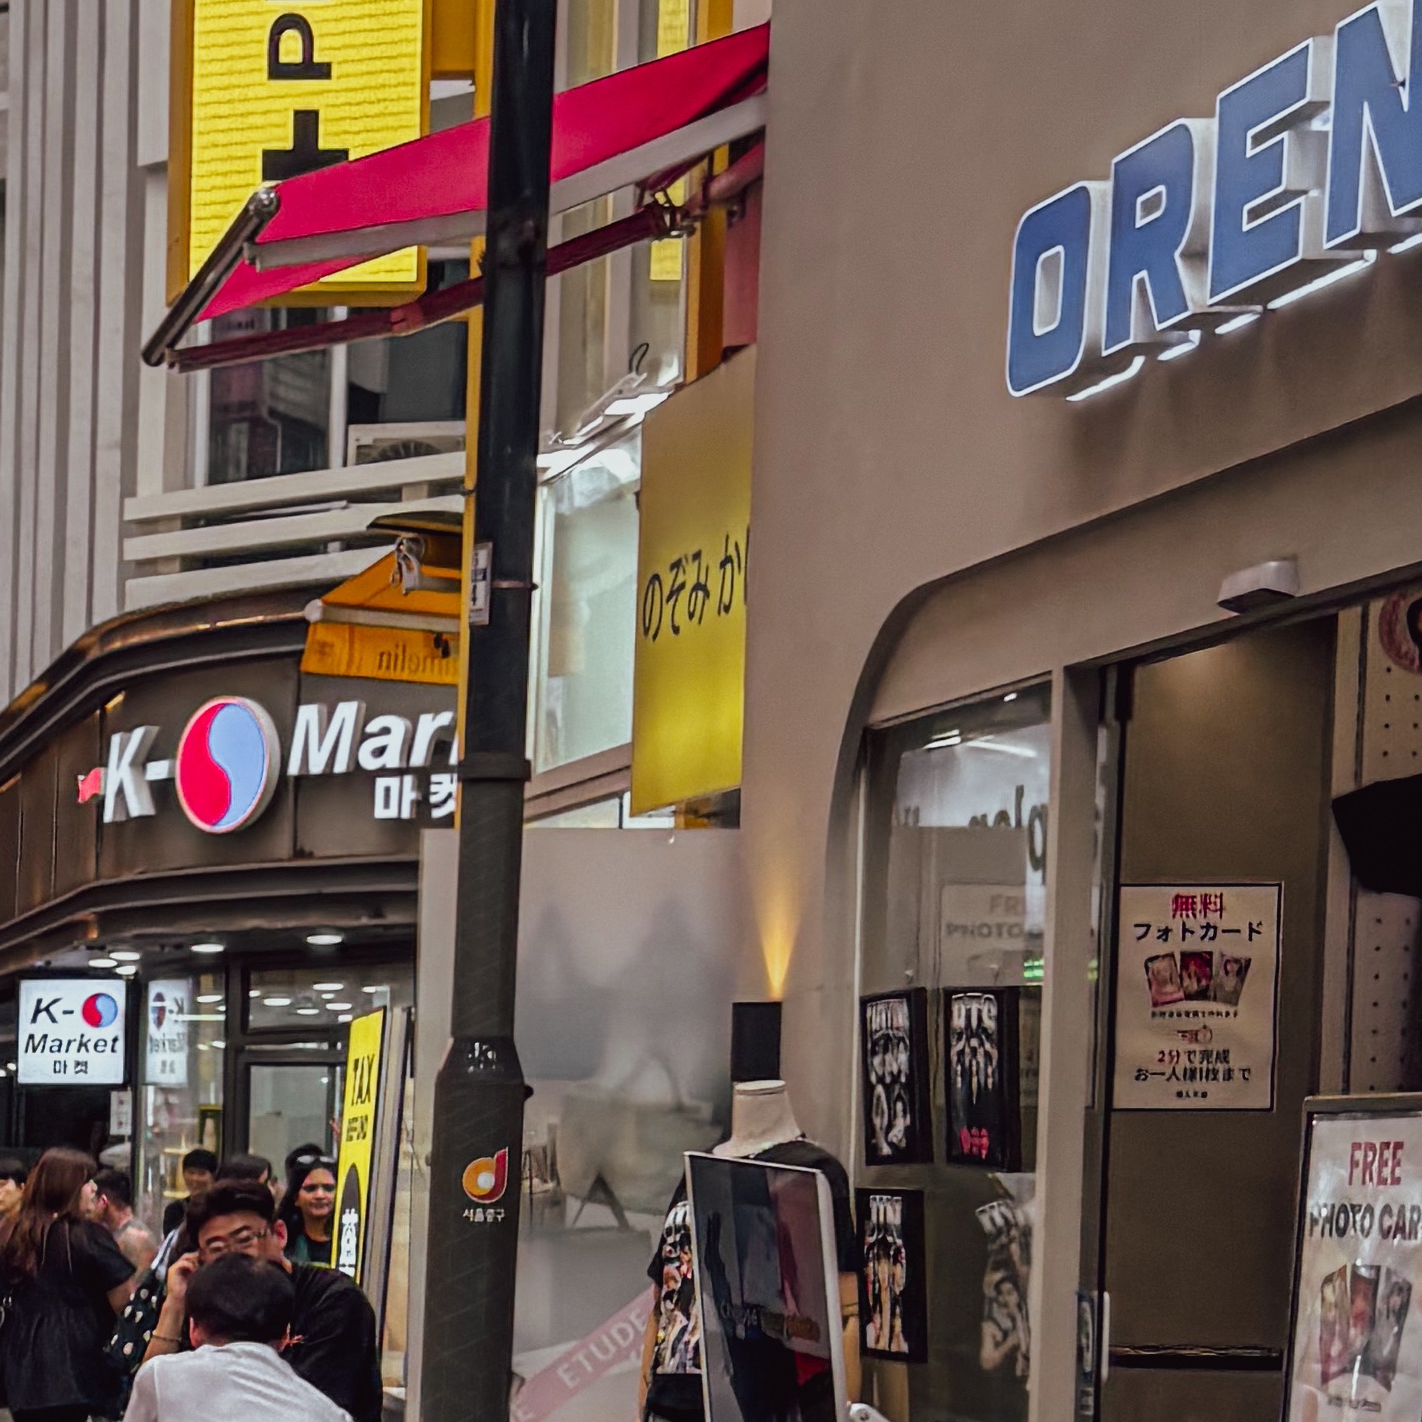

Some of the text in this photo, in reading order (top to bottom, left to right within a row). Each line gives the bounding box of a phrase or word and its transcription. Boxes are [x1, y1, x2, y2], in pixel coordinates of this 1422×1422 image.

[289, 700, 458, 776] Mar
[1172, 892, 1225, 919] 無料
[1133, 920, 1263, 942] フォトカード
[24, 1033, 119, 1054] Market
[351, 1053, 375, 1106] TAX
[1348, 1141, 1404, 1187] FREE
[1308, 1202, 1374, 1240] PHOTO
